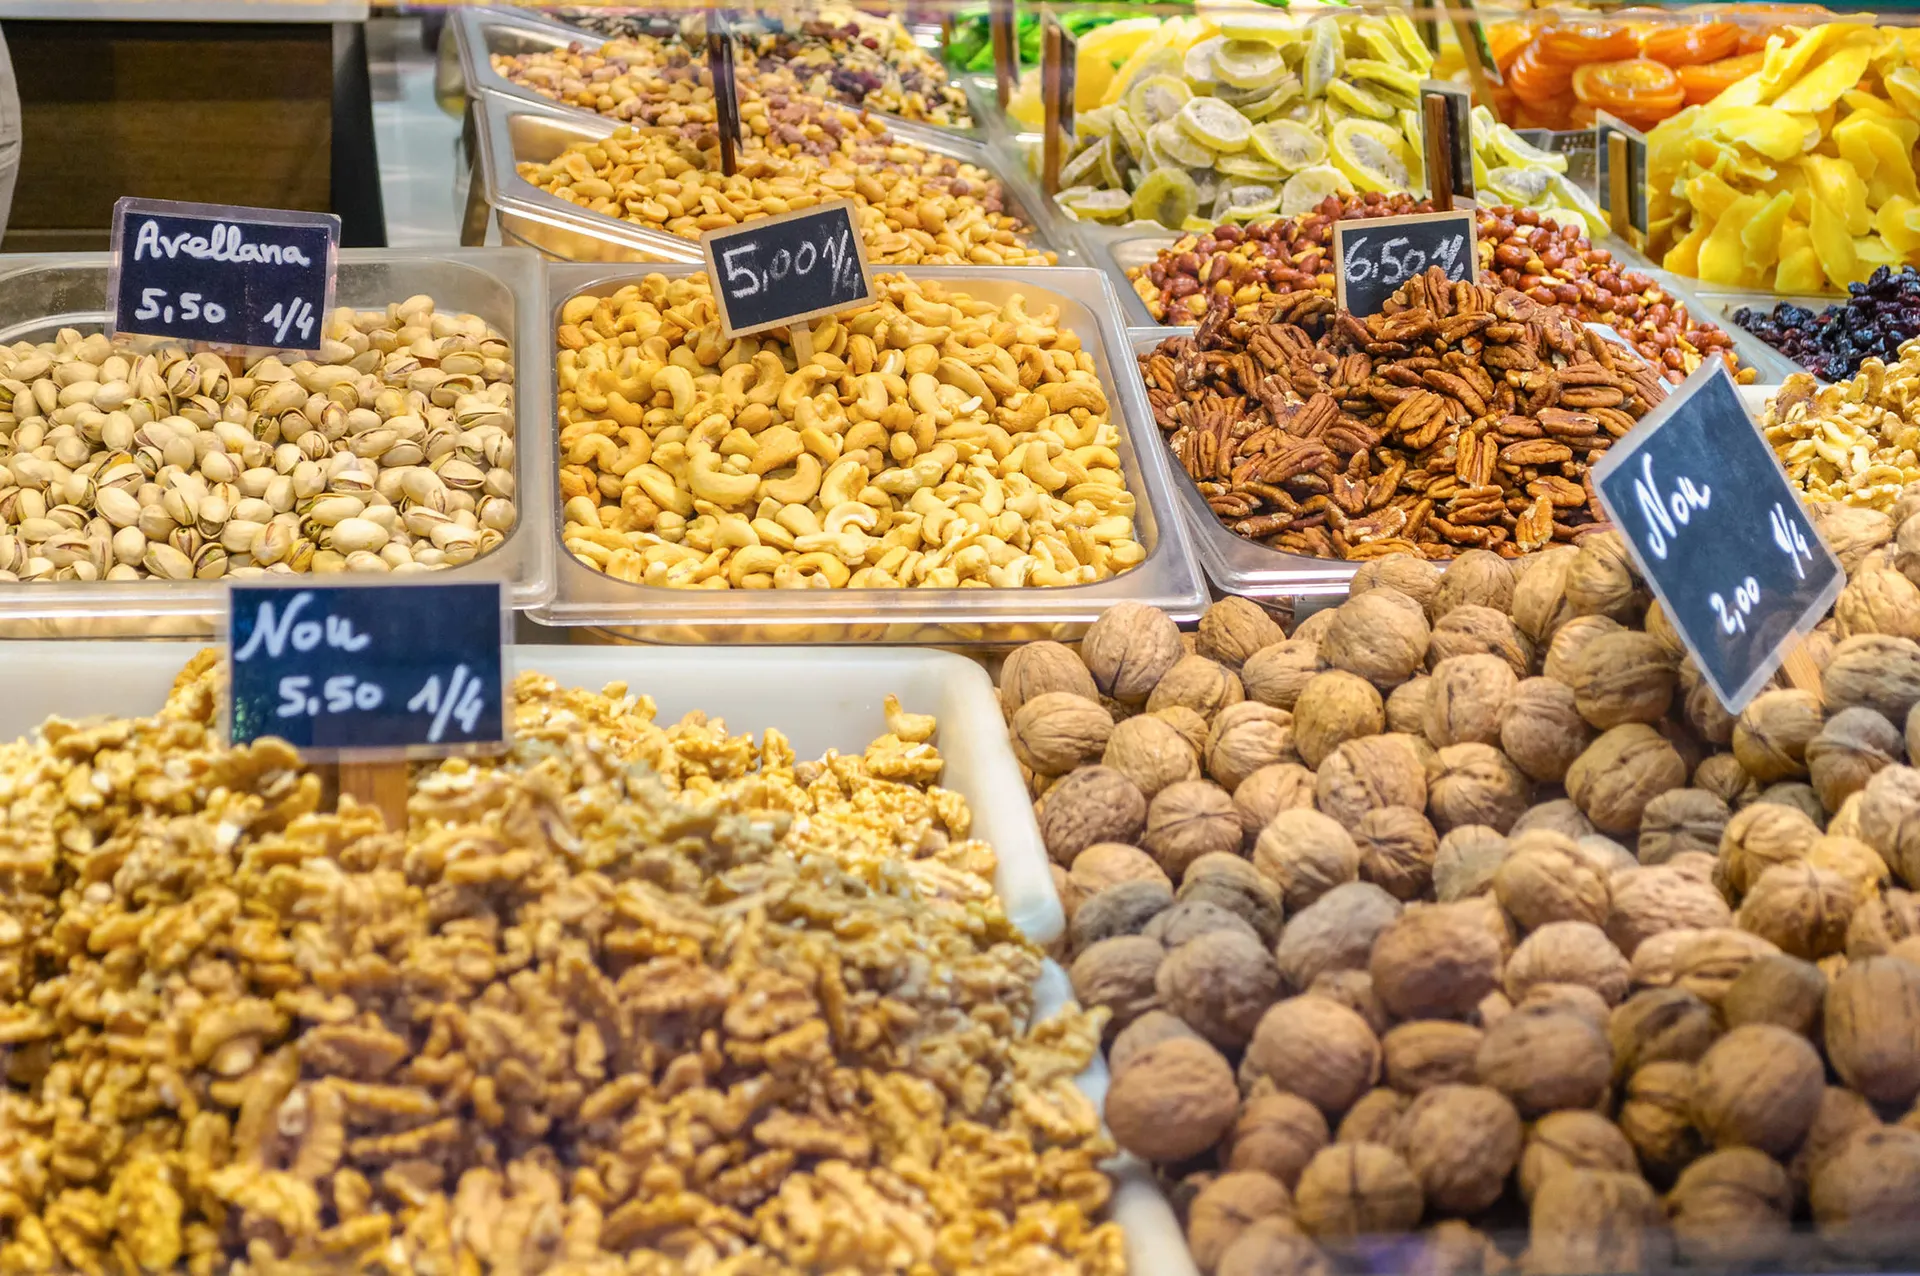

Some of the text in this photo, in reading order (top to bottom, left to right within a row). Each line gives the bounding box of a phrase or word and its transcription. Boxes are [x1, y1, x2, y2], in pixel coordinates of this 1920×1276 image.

[134, 219, 311, 268] Avellana
[722, 229, 860, 299] 5,00 1/4
[1344, 236, 1426, 285] 6,50
[263, 296, 315, 345] 1/4
[1634, 452, 1712, 560] Nou
[234, 592, 371, 662] Nou
[1710, 576, 1760, 635] 2,00
[406, 663, 484, 743] 1/4
